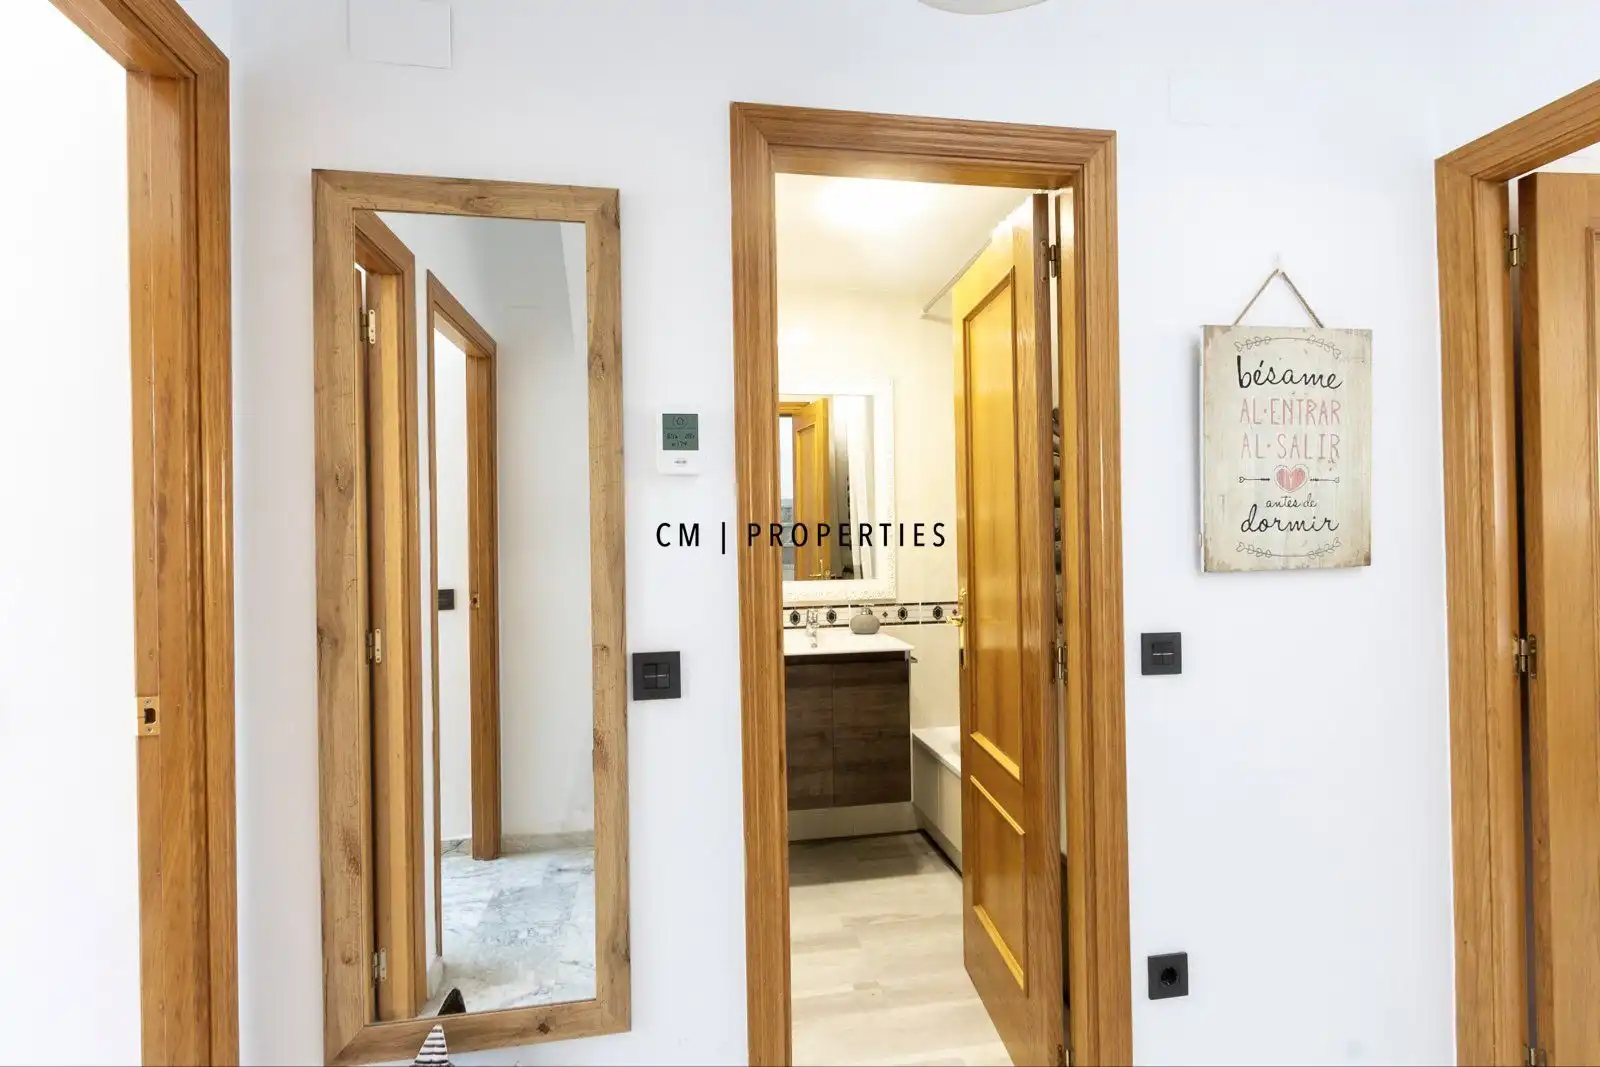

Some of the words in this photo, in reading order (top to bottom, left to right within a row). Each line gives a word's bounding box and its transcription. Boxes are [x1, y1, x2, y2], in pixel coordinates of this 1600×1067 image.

[1237, 355, 1343, 389] bésame
[1277, 433, 1340, 462] SALIR
[1266, 495, 1301, 508] antes
[1302, 492, 1318, 508] de
[1240, 503, 1340, 532] dormir
